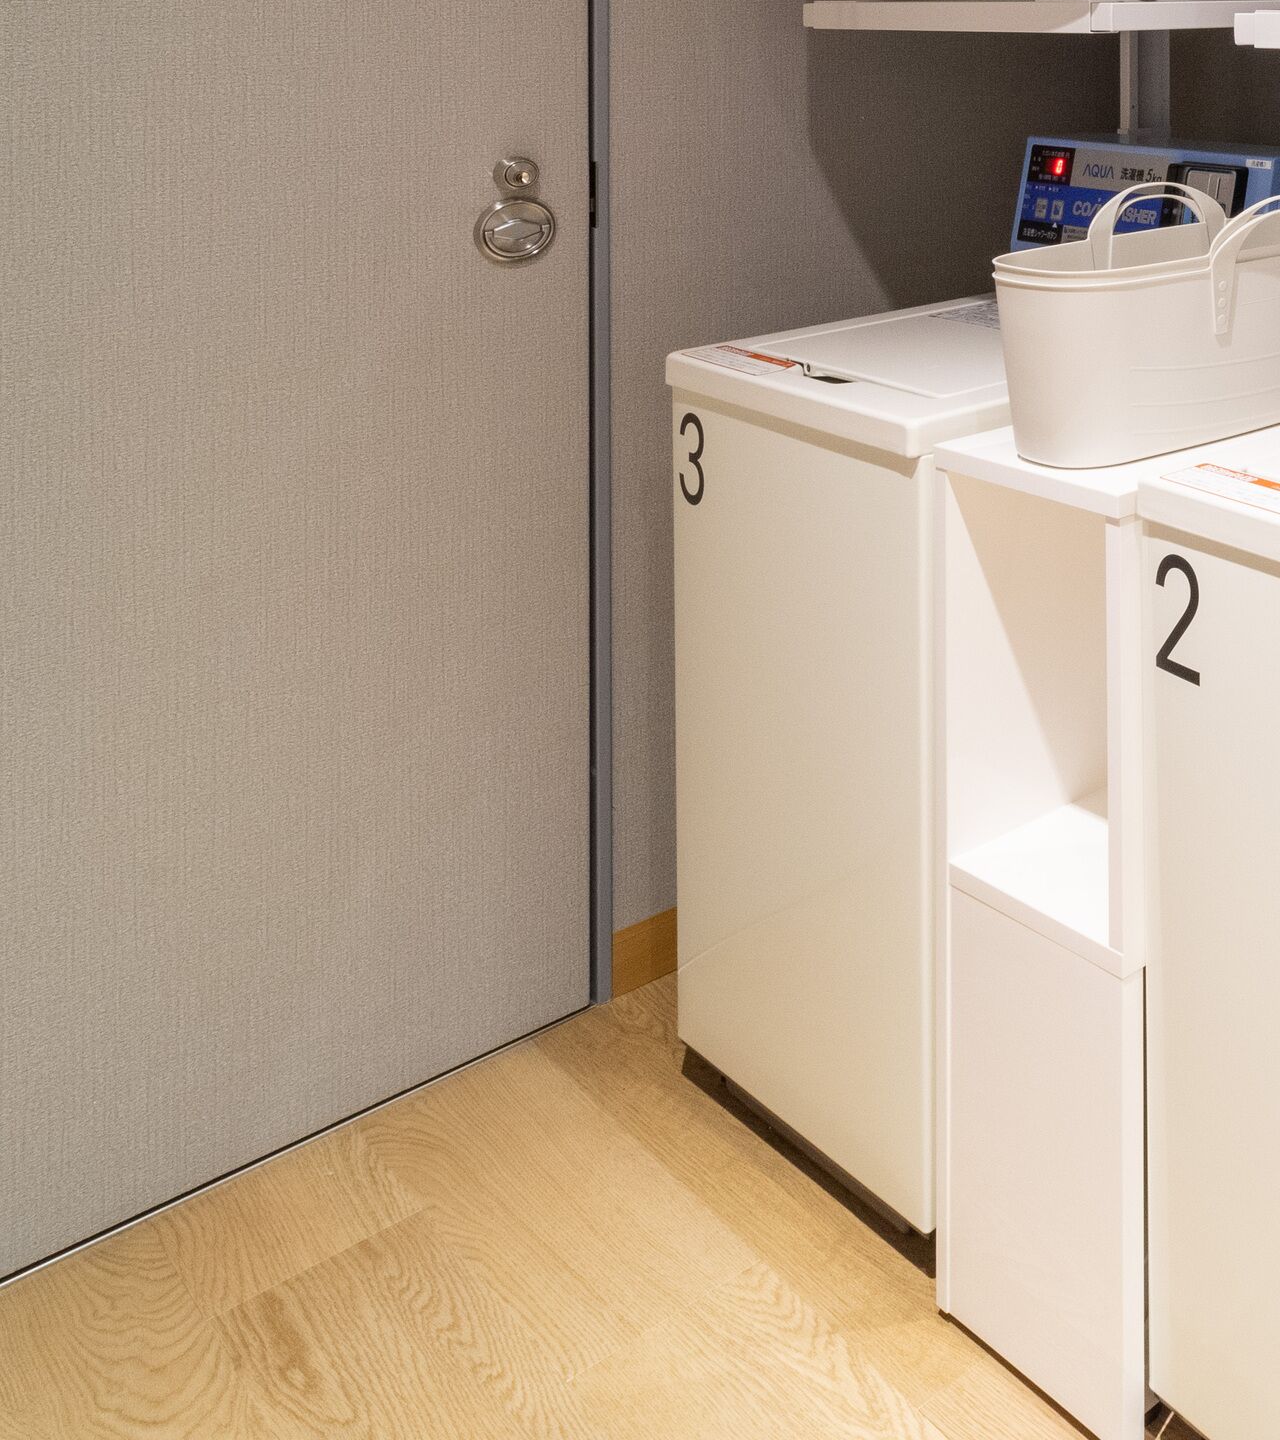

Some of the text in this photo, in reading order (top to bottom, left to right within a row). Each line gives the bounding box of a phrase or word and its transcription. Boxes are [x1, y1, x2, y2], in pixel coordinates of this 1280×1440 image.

[1083, 164, 1114, 180] AQUA
[1120, 168, 1144, 181] 洗濯機
[679, 412, 705, 506] 3
[1155, 553, 1200, 687] 2
